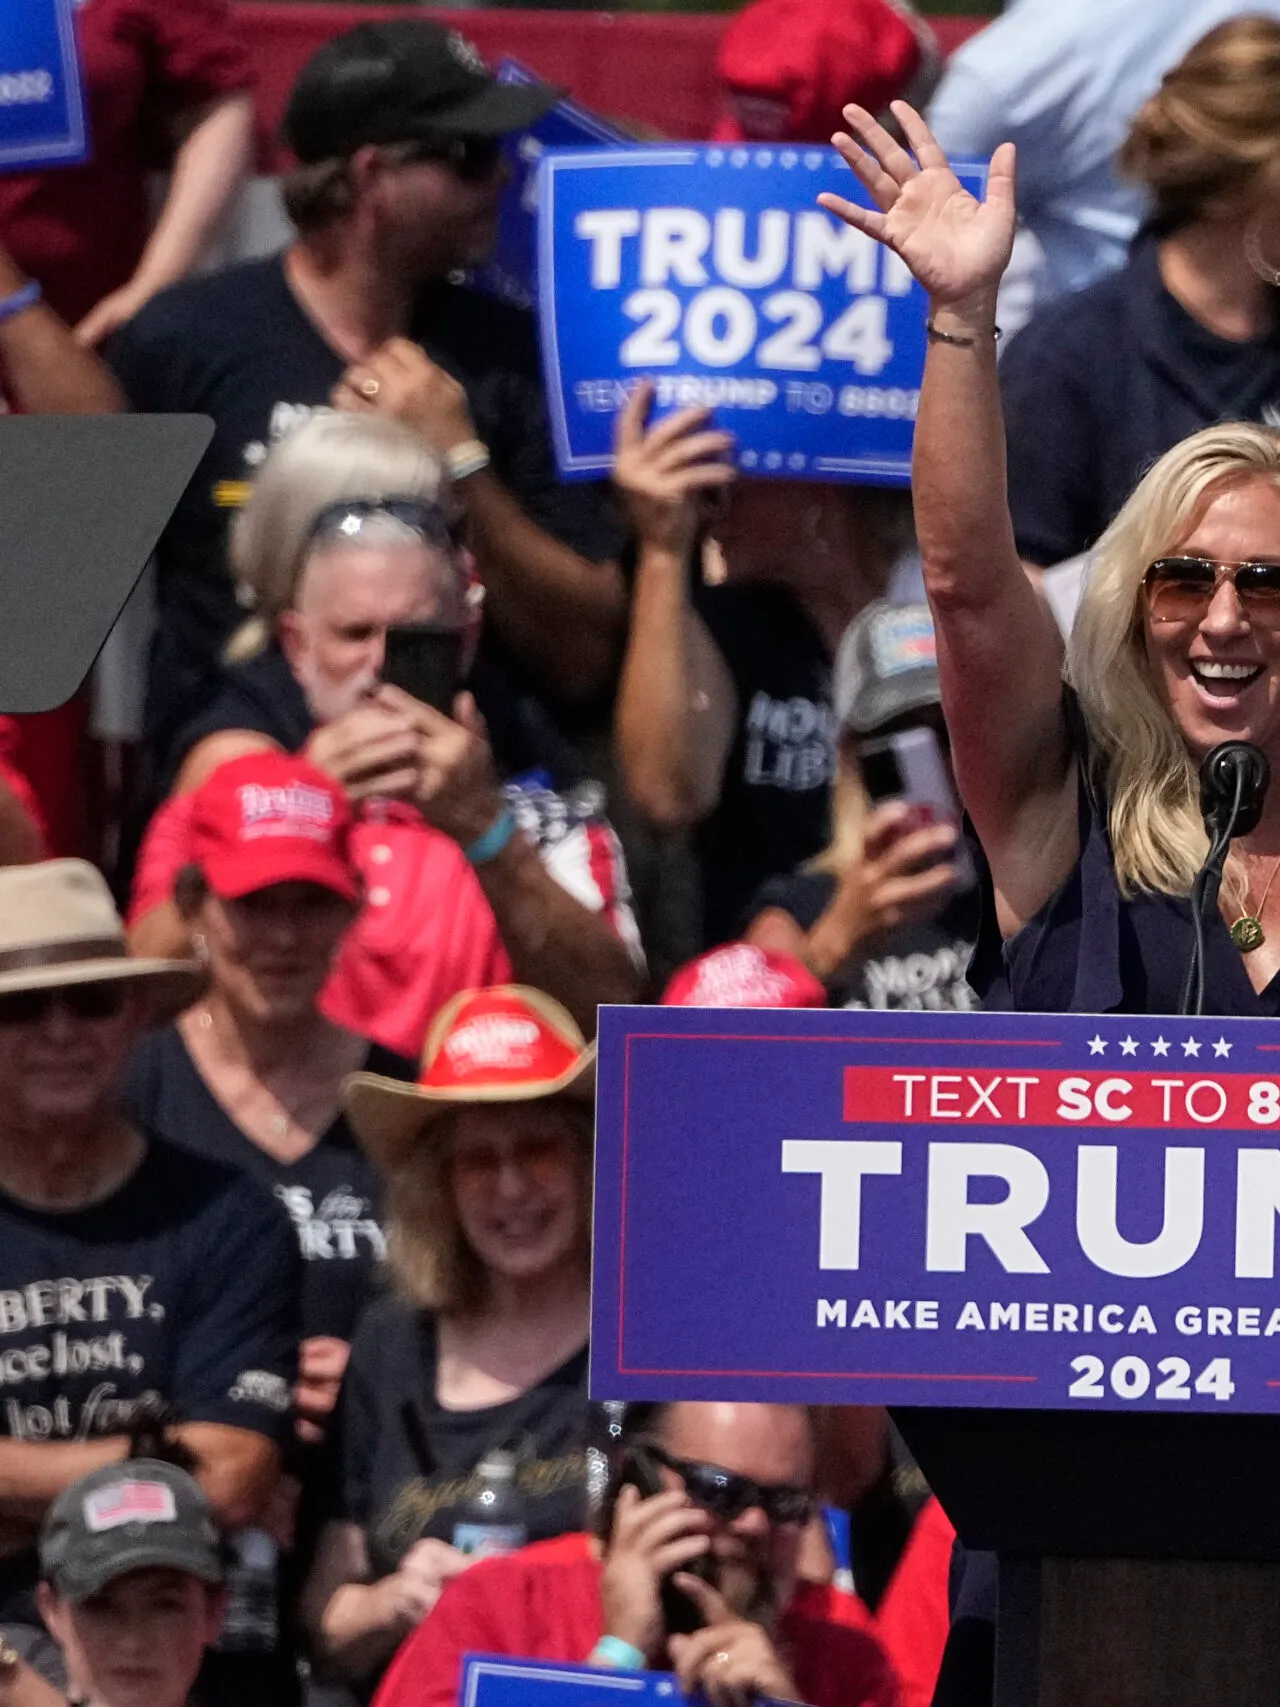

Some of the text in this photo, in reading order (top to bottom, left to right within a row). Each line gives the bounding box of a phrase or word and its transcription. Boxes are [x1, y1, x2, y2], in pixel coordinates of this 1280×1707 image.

[619, 287, 893, 375] 2024
[655, 376, 778, 410] TRUMP
[893, 1075, 1040, 1119] TEXT
[1056, 1077, 1133, 1121] SC
[1151, 1080, 1227, 1123] TO
[816, 1299, 939, 1329] MAKE
[955, 1302, 1157, 1334] AMERICA
[1068, 1354, 1235, 1401] 2024
